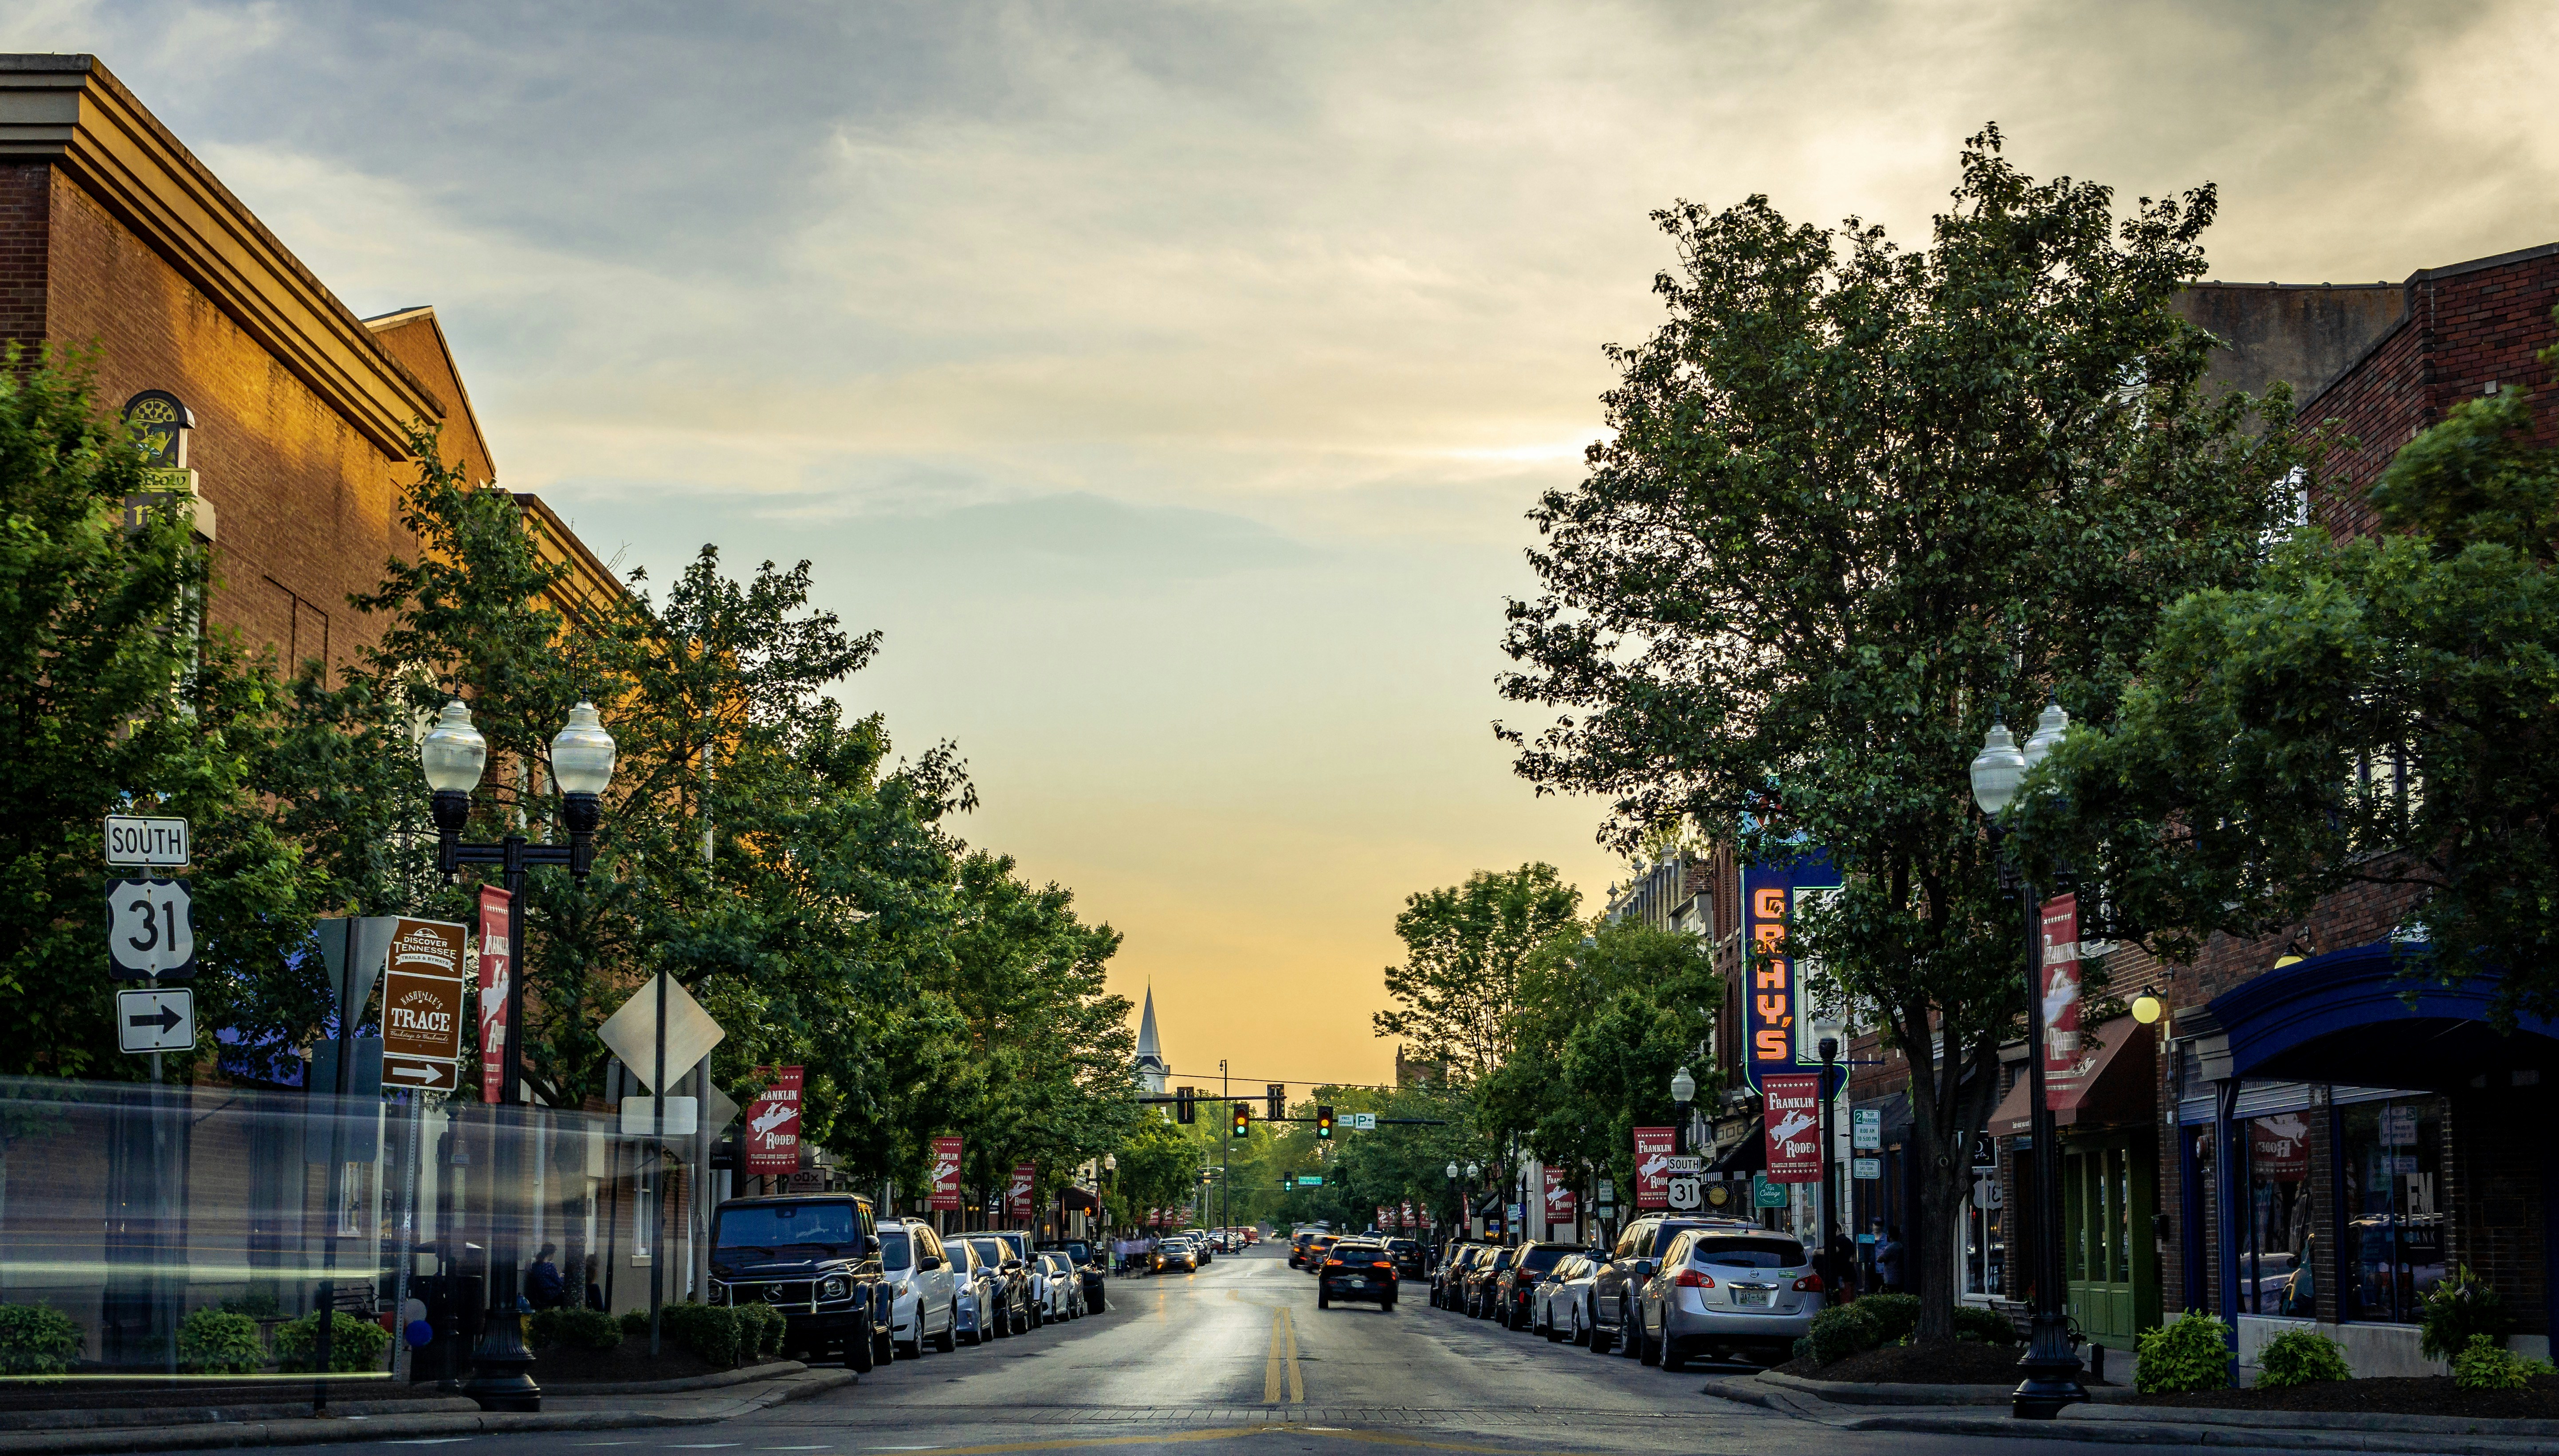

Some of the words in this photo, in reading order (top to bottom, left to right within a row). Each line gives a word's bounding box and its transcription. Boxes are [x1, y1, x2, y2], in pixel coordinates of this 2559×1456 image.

[112, 827, 181, 854] SOUTH
[128, 899, 176, 951] 31
[393, 941, 457, 959] TENNESSEE
[404, 936, 447, 947] DISCOVER
[1755, 888, 1792, 1060] GRAY'S
[400, 991, 443, 1009] NASHVILLE'S
[391, 1008, 450, 1032] TRACE
[761, 1090, 797, 1100] RANKLIN
[1768, 1093, 1814, 1110] FRANKLIN
[1856, 1113, 1862, 1122] 2
[765, 1132, 796, 1150] RODEO
[1638, 1140, 1672, 1154] FRANKLIN
[1786, 1140, 1816, 1158] RODEO
[1669, 1159, 1699, 1169] SOUTH
[936, 1181, 957, 1193] RODEO
[1674, 1184, 1693, 1201] 31
[1014, 1197, 1030, 1206] RODEO
[1555, 1200, 1572, 1210] RODEO
